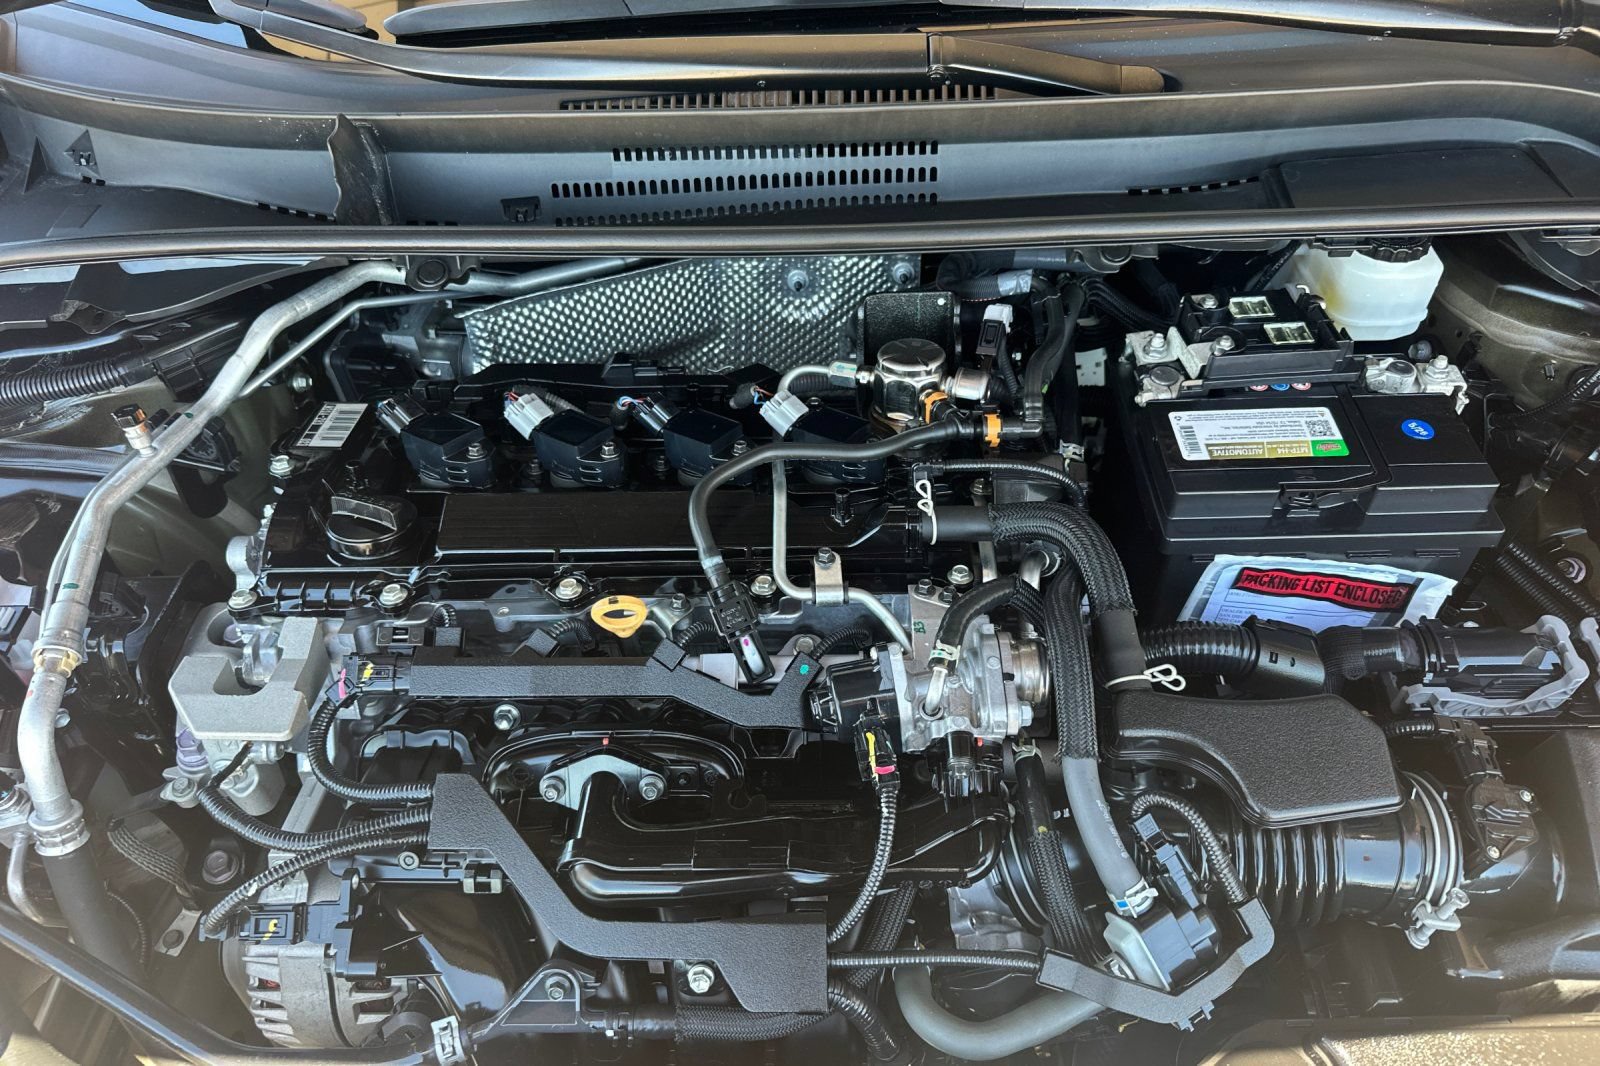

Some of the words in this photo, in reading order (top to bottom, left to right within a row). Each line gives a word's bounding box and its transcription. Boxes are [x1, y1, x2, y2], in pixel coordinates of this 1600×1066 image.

[1212, 448, 1263, 457] AUTOMOTIVE
[1243, 574, 1302, 590] PACKING
[1302, 578, 1334, 593] LIST
